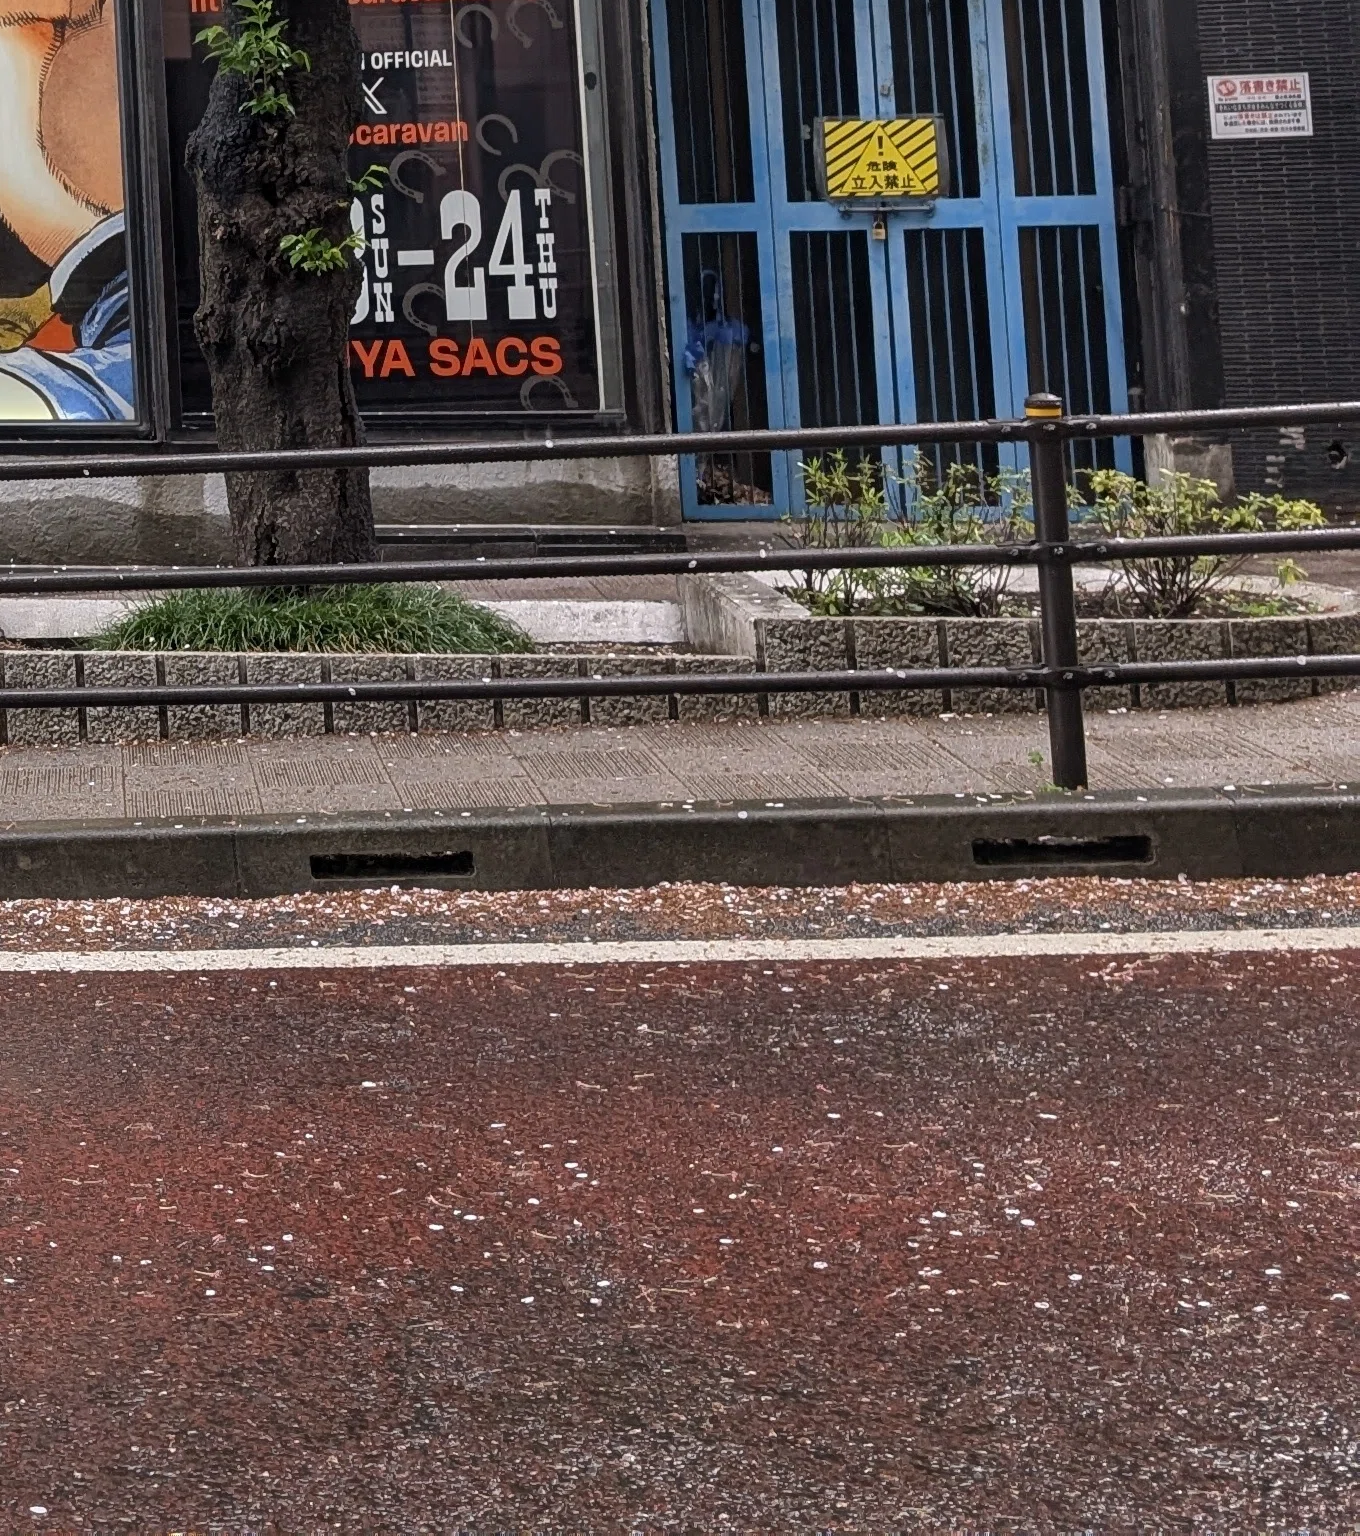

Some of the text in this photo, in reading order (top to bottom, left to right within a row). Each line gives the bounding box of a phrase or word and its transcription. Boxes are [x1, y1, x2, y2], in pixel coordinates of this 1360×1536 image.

[371, 49, 453, 70] OFFICIAL
[349, 119, 469, 146] caravan
[866, 160, 898, 172] 危険
[851, 173, 917, 190] 立入禁止
[371, 193, 395, 323] SUN
[534, 187, 558, 319] THU
[429, 336, 564, 377] SACS
